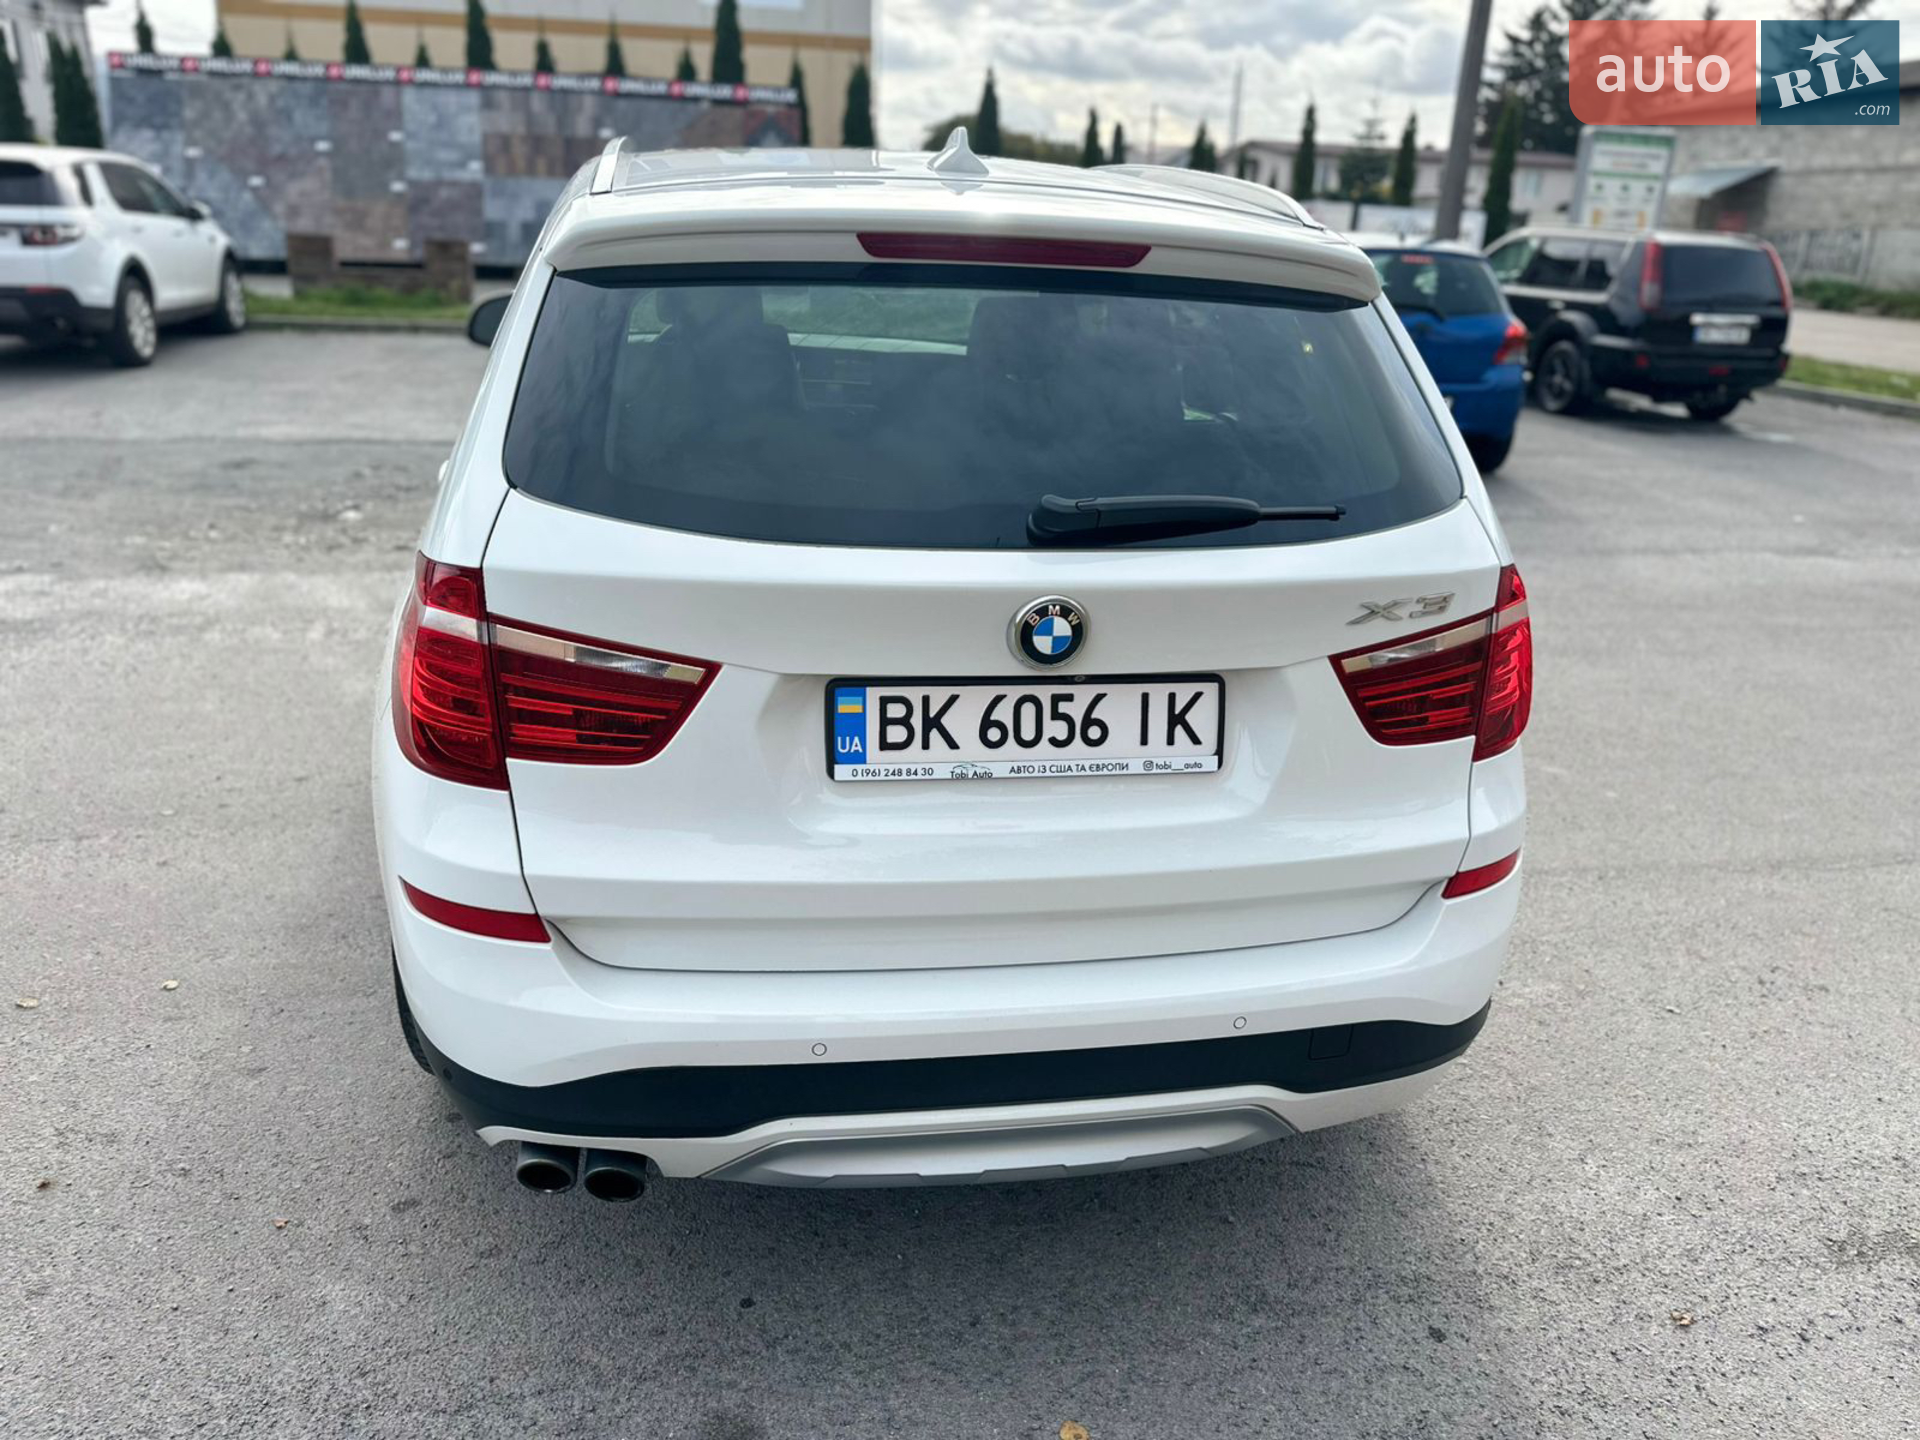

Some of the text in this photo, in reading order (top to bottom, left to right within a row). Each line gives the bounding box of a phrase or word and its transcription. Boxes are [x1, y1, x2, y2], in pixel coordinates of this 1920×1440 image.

[1027, 604, 1081, 626] BMW
[1345, 591, 1456, 625] X3
[879, 691, 1204, 751] BK 6056 IK
[837, 736, 863, 753] UA
[851, 767, 934, 777] 0 (96) 248 84 30
[950, 769, 993, 779] Tobi Auto
[1009, 765, 1035, 775] АВТО
[1049, 764, 1073, 774] США
[1075, 763, 1087, 773] ТА
[1088, 762, 1129, 773] ЄВРОПИ
